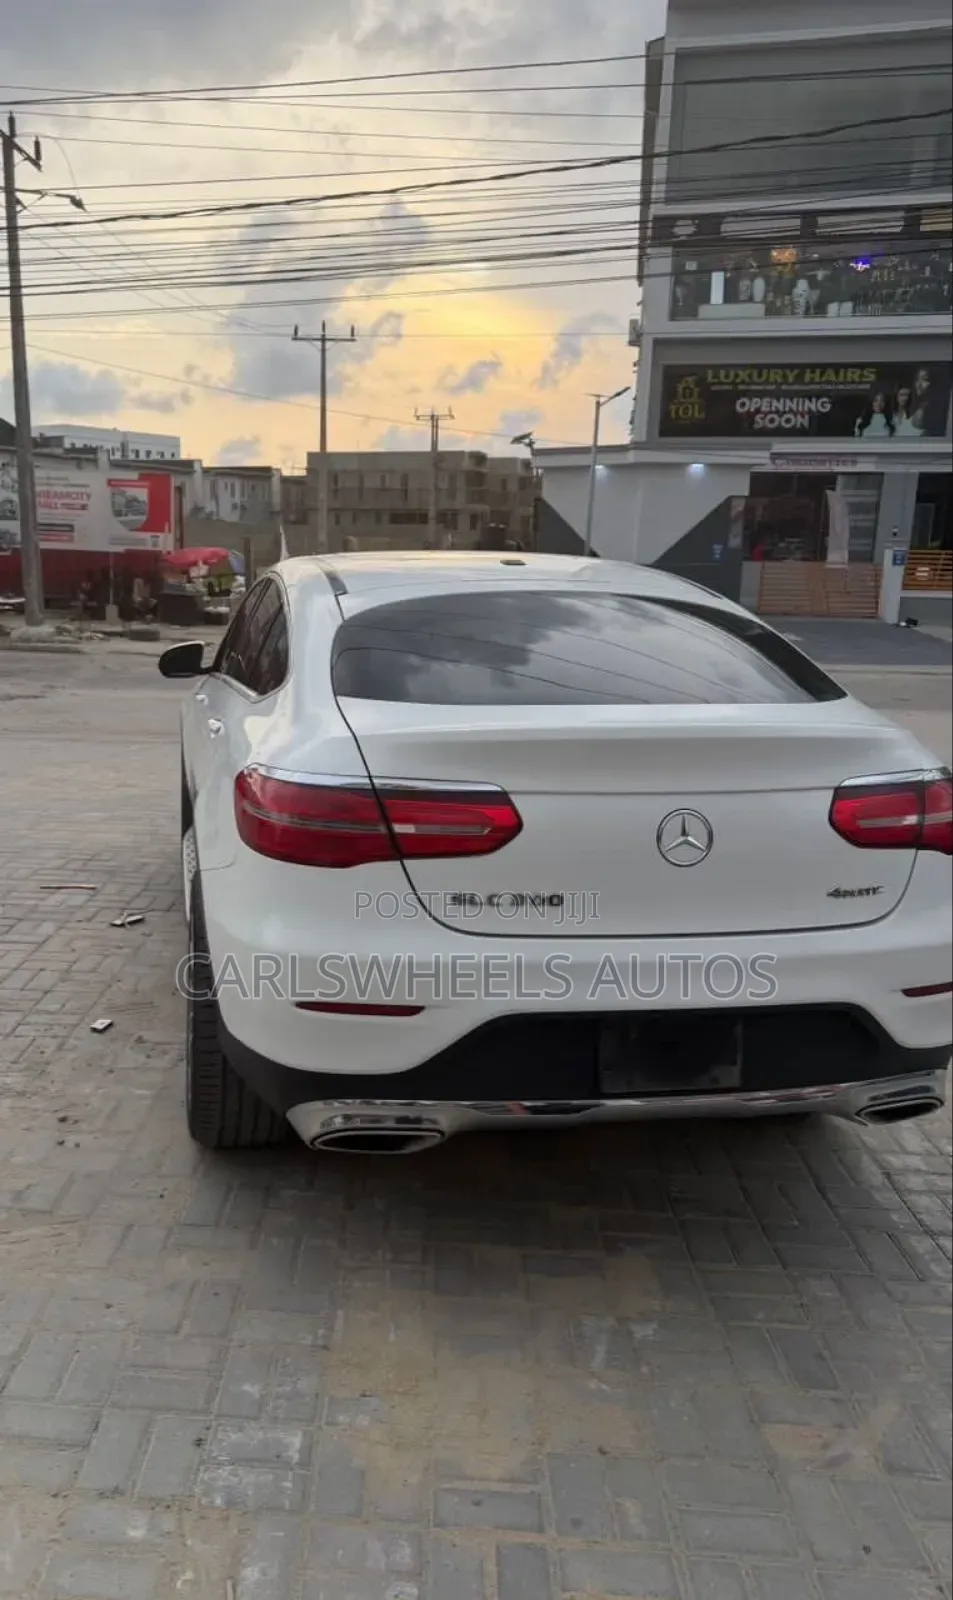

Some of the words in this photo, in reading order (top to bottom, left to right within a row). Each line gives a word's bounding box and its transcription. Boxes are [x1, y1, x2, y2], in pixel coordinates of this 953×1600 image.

[707, 368, 800, 383] LUXURY
[803, 367, 877, 382] HAIRS
[735, 396, 831, 413] OPENNING
[753, 413, 810, 429] SOON
